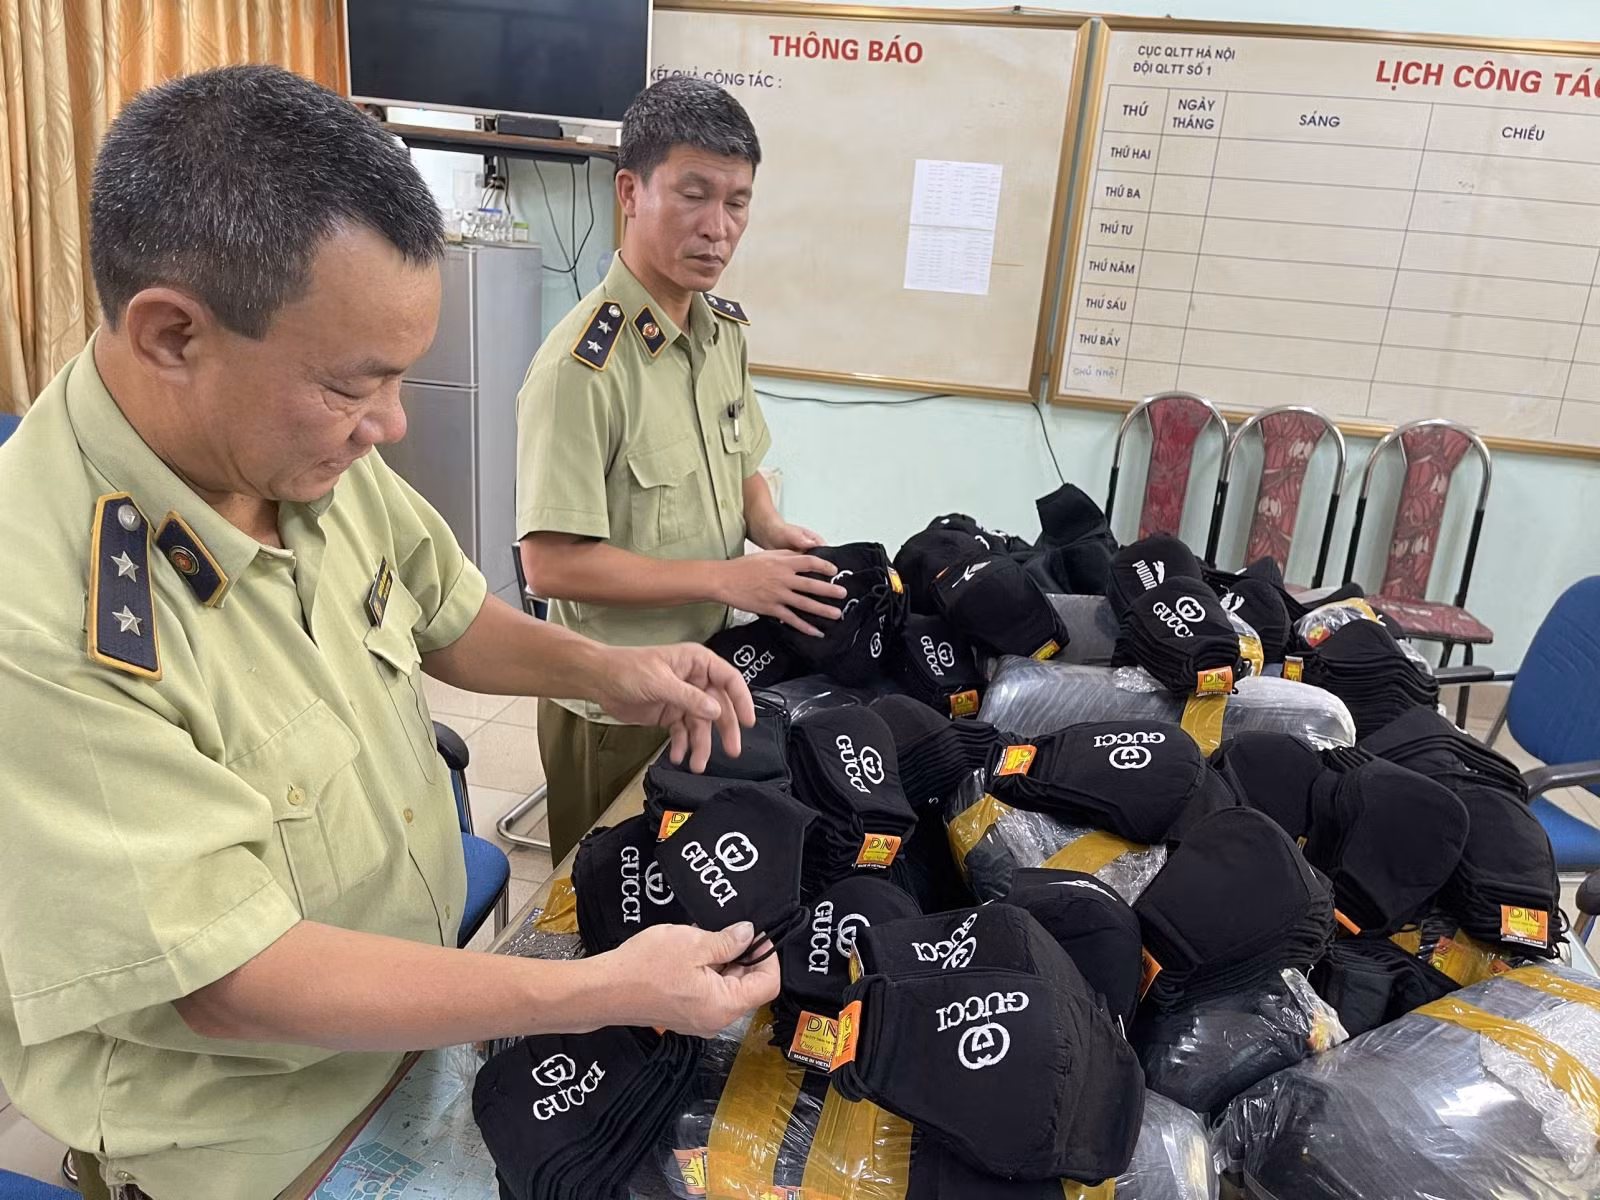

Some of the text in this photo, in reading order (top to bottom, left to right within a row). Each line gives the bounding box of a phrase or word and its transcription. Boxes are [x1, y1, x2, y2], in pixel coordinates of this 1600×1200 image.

[769, 31, 923, 64] THÔNG BÁO
[1138, 45, 1162, 58] CỤC
[1164, 46, 1193, 57] QLTT
[1214, 47, 1236, 62] NỘI
[704, 68, 745, 86] CÔNG
[748, 69, 774, 88] TÁC
[1133, 60, 1212, 76] ĐỘI QLTT SỐ 1
[1376, 60, 1444, 91] LỊCH
[1453, 60, 1542, 94] CÔNG
[1172, 114, 1215, 130] THÁNG
[1299, 110, 1340, 128] SÁNG
[1132, 148, 1151, 160] HAI
[1126, 187, 1141, 199] BA
[1106, 297, 1127, 311] SÁU
[1132, 559, 1158, 591] PUMA
[920, 635, 945, 676] GUCCI
[1093, 731, 1166, 748] GUCCI
[869, 837, 895, 850] DN
[620, 846, 641, 924] GUCCI
[681, 841, 738, 908] GUCCI
[808, 900, 834, 975] GUCCI
[911, 912, 978, 962] GUCCI
[935, 991, 1030, 1032] GUCCI
[807, 1015, 839, 1038] DN
[532, 1060, 606, 1120] GUCCI
